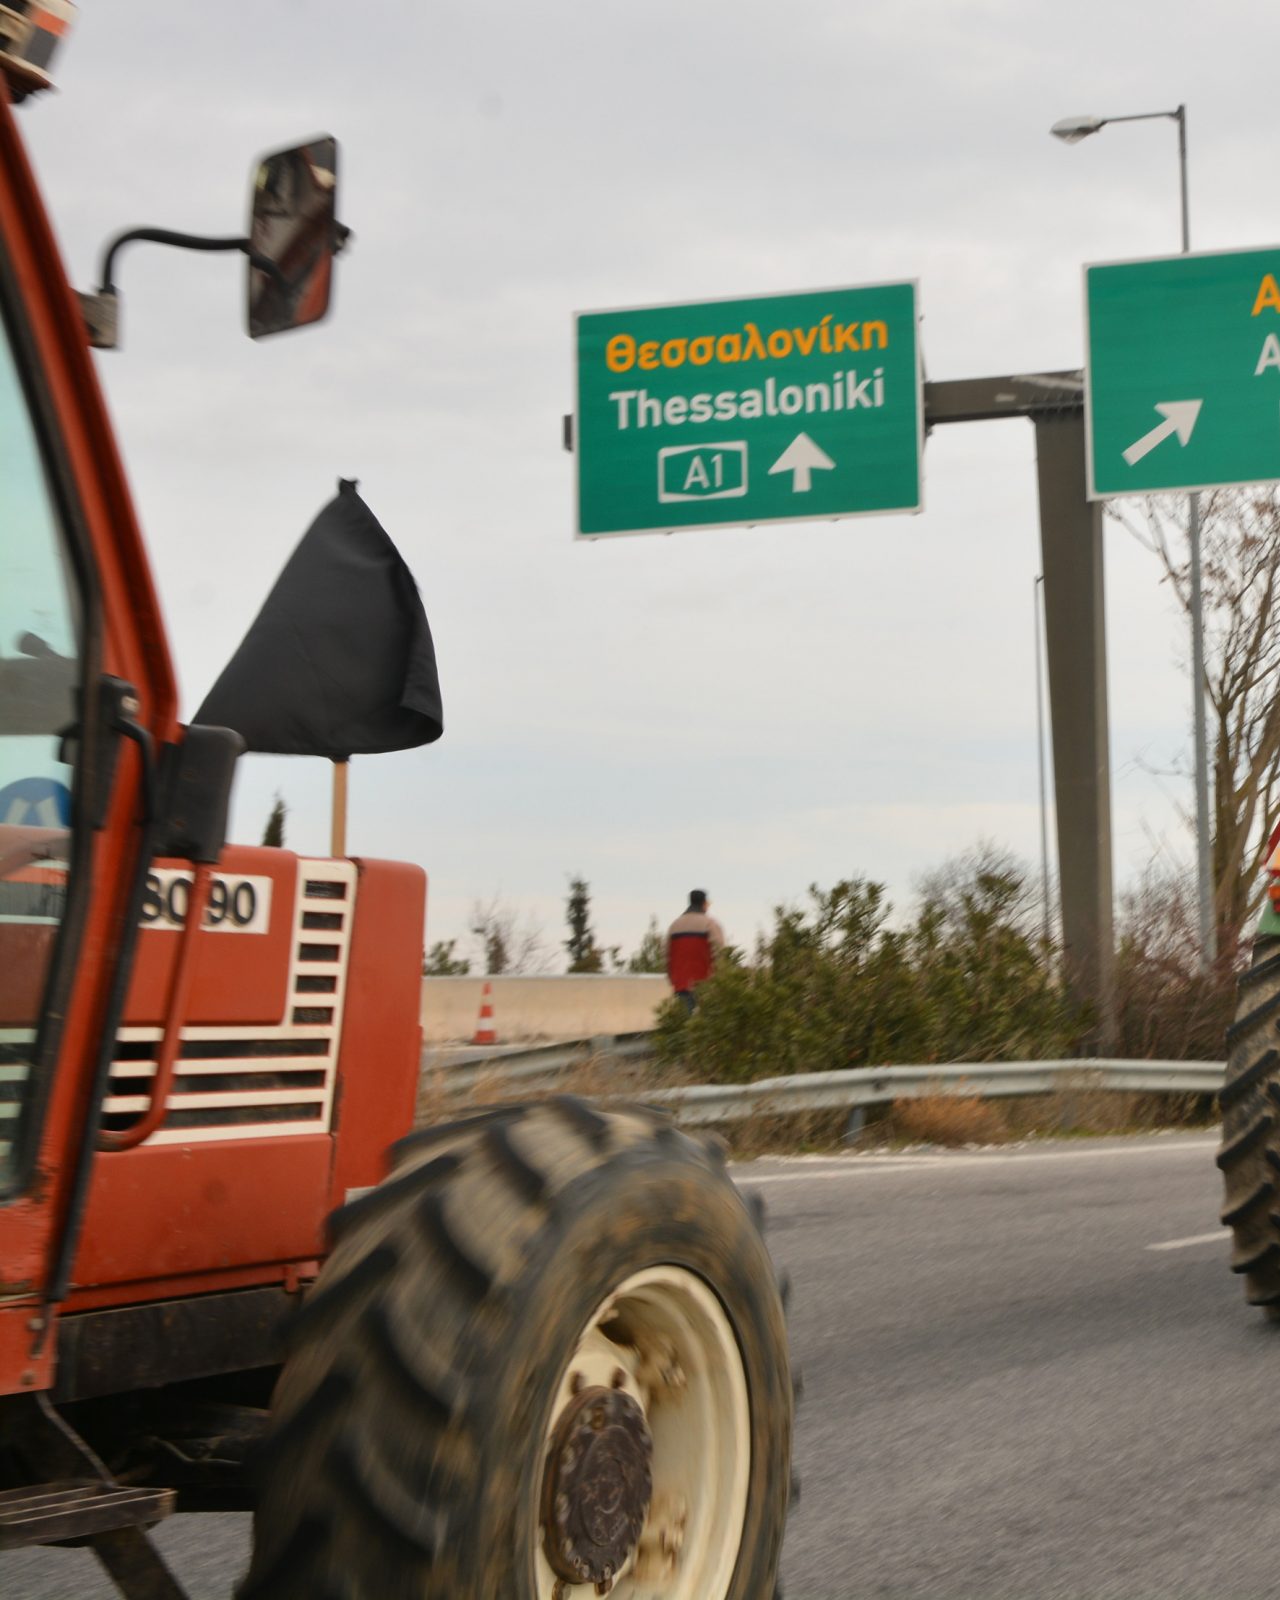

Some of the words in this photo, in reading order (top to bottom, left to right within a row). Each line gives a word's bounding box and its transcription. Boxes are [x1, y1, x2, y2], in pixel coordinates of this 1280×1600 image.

[606, 314, 888, 373] Θεσσαλονίκη
[608, 367, 885, 430] Thessaloniki
[683, 453, 723, 491] A1
